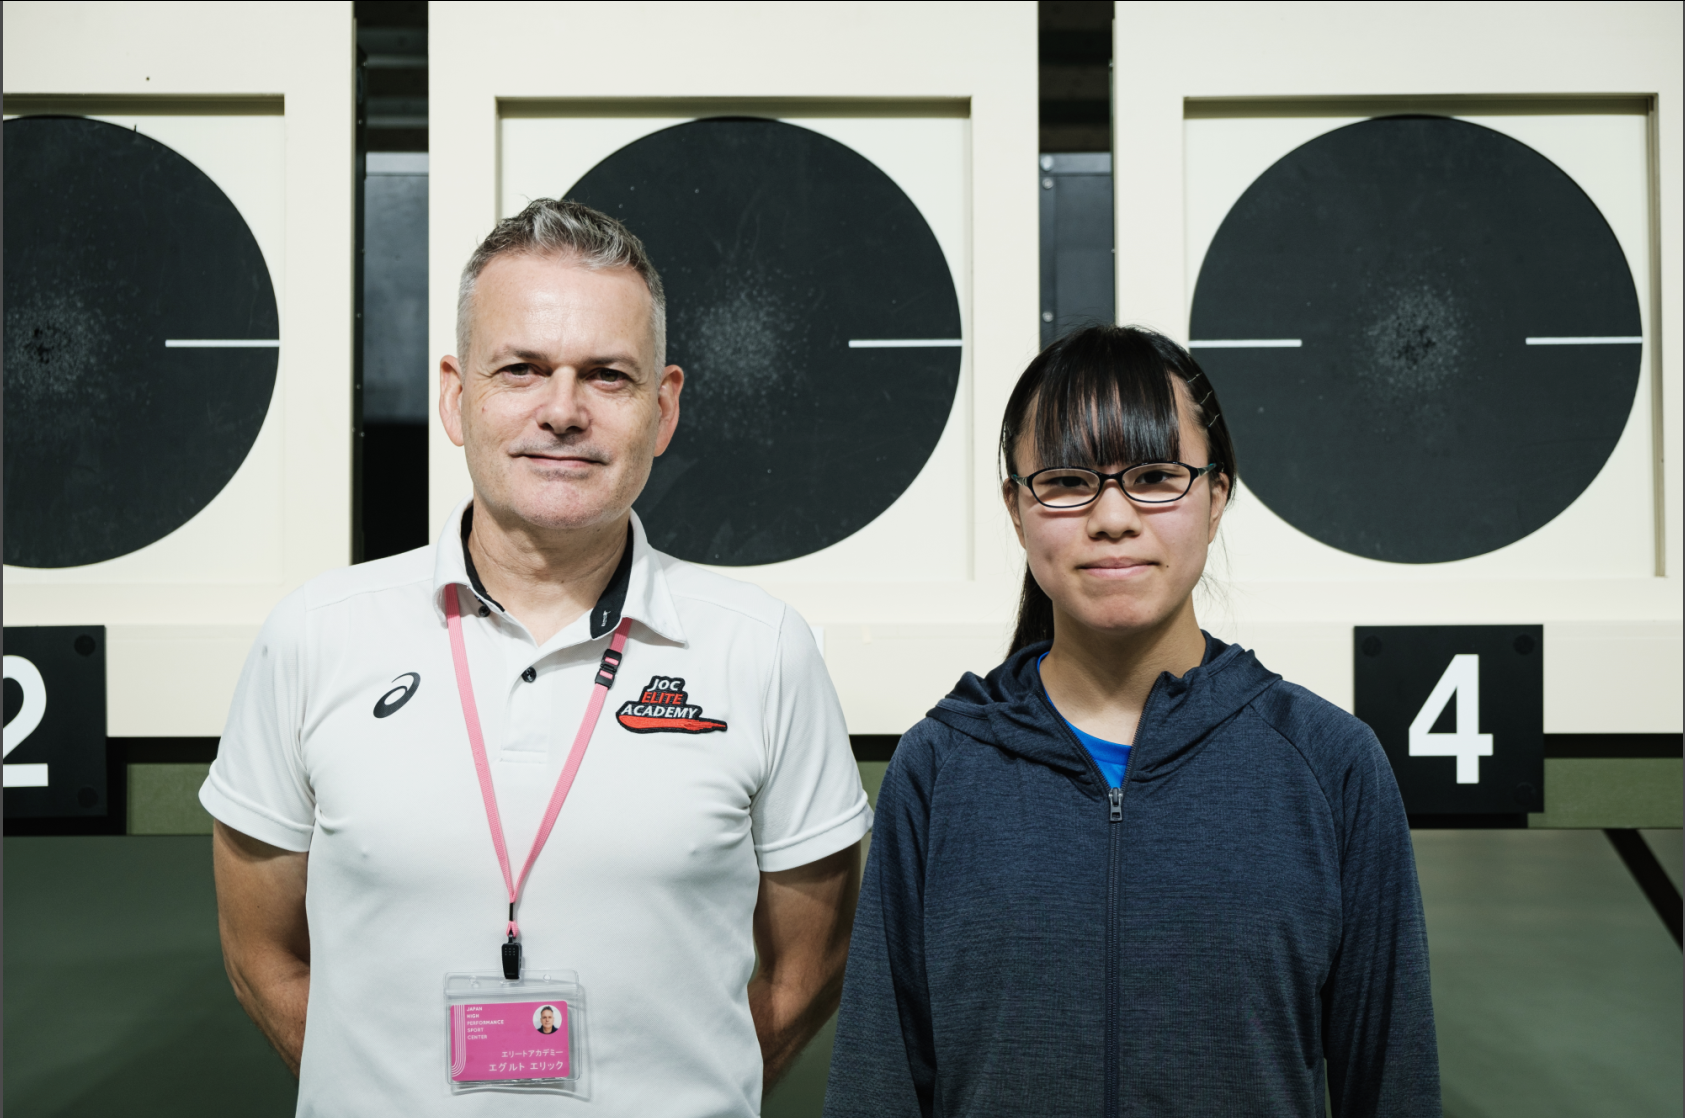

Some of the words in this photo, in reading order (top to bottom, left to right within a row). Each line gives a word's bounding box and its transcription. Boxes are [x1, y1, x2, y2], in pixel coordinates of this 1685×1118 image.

[646, 678, 681, 692] JOC
[641, 691, 684, 705] ELITE
[620, 704, 698, 719] ACADEMY
[3, 655, 48, 787] 2
[1409, 654, 1493, 784] 4
[501, 1048, 564, 1058] エリートアカデミー
[488, 1062, 525, 1072] エグルト
[529, 1060, 564, 1071] エリック
